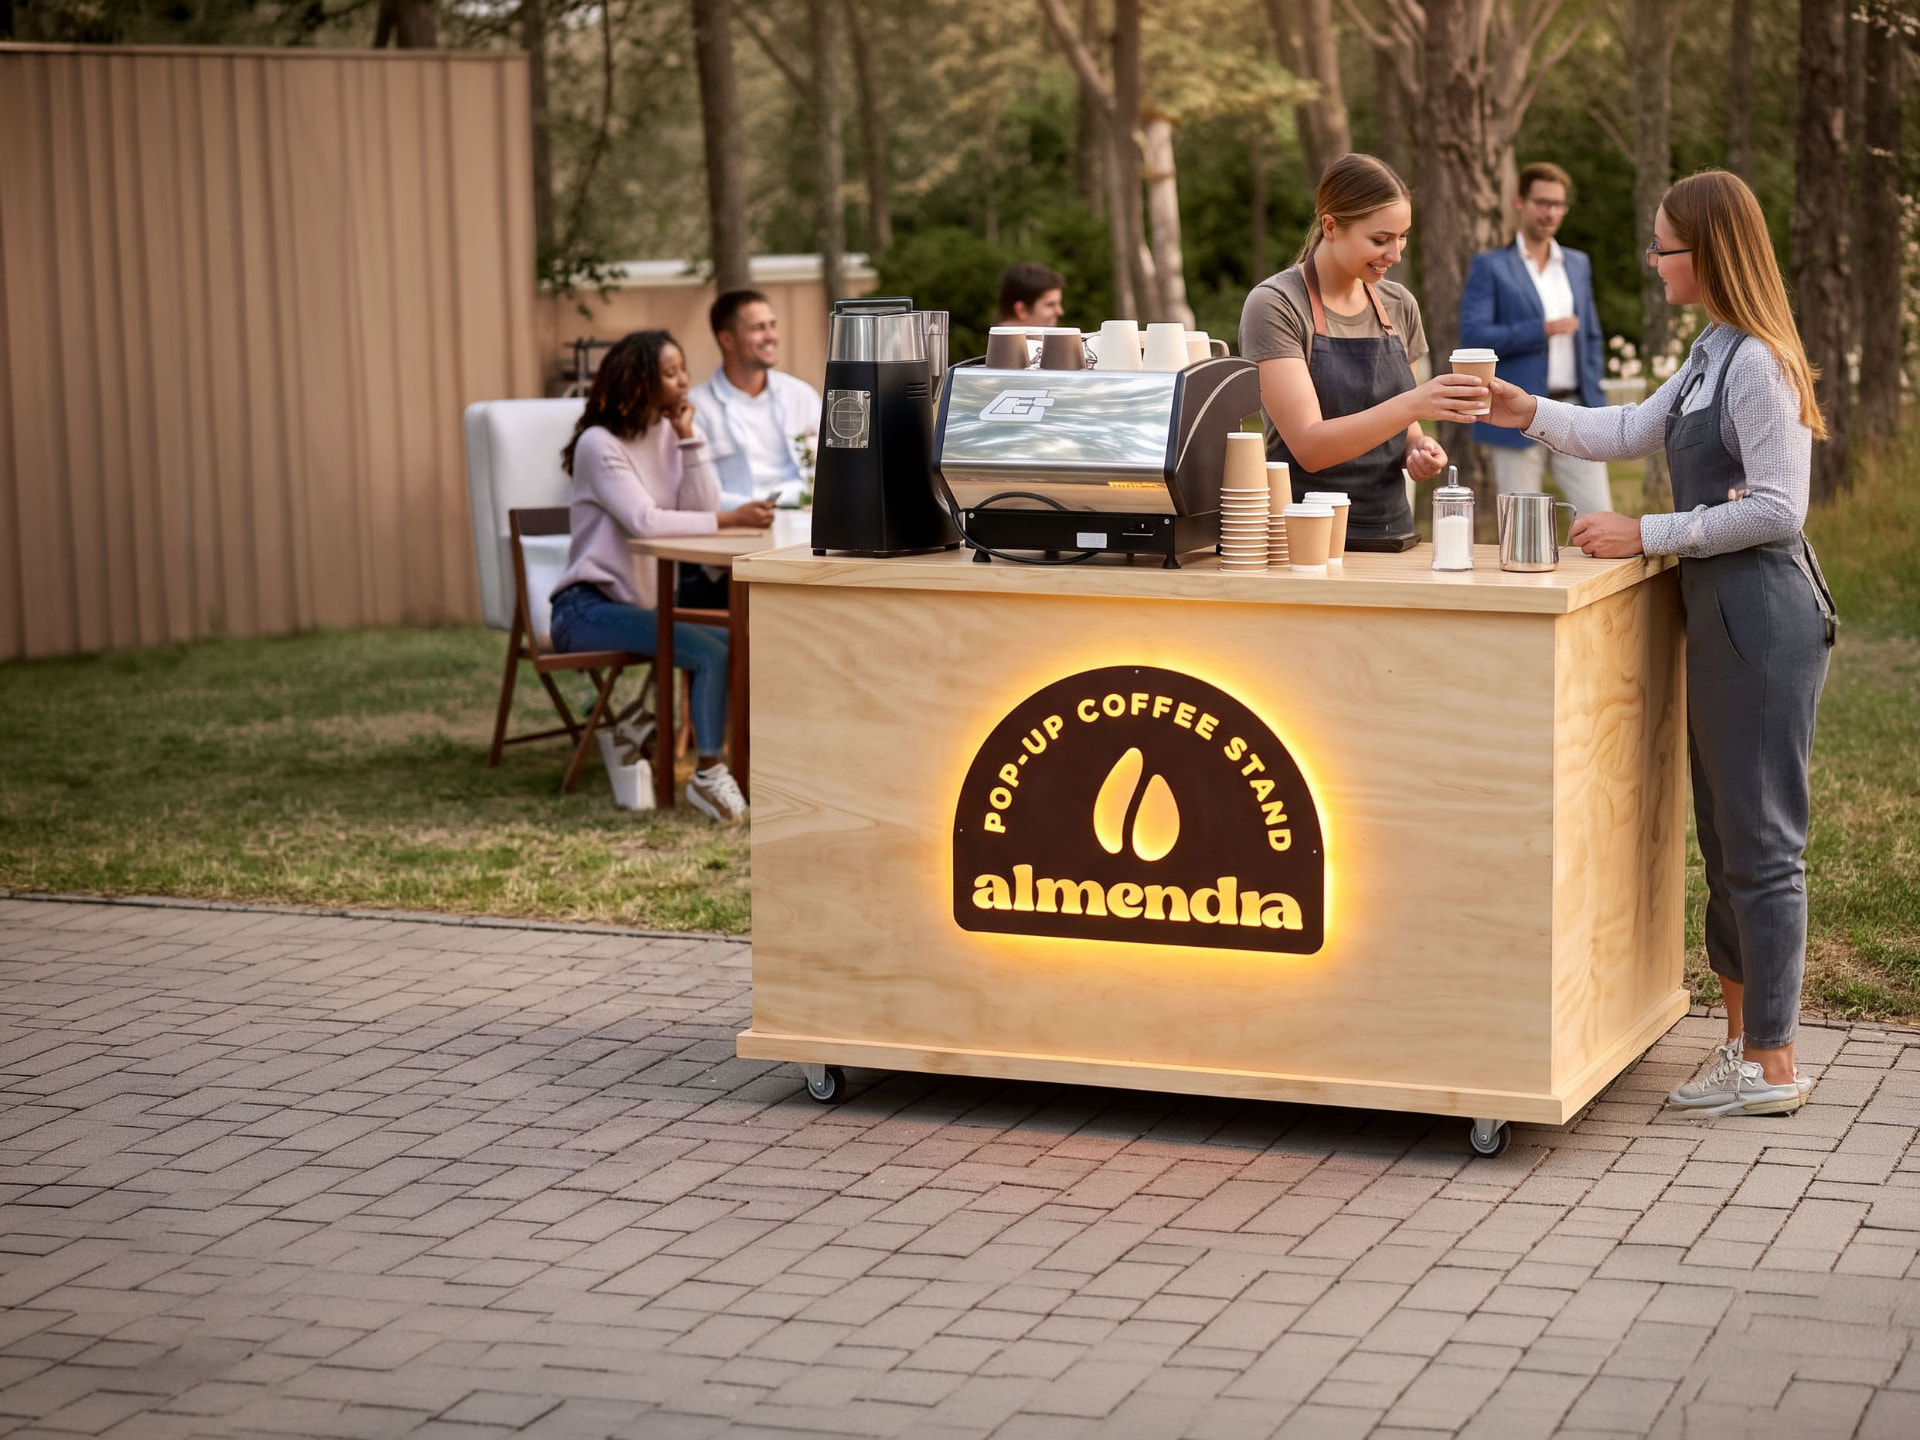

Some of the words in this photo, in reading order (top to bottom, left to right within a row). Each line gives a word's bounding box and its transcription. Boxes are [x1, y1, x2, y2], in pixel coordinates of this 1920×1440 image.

[983, 714, 1064, 834] POP-UP
[1077, 693, 1220, 741] COFFEE
[1223, 736, 1292, 852] STAND
[972, 863, 1304, 931] almendra
